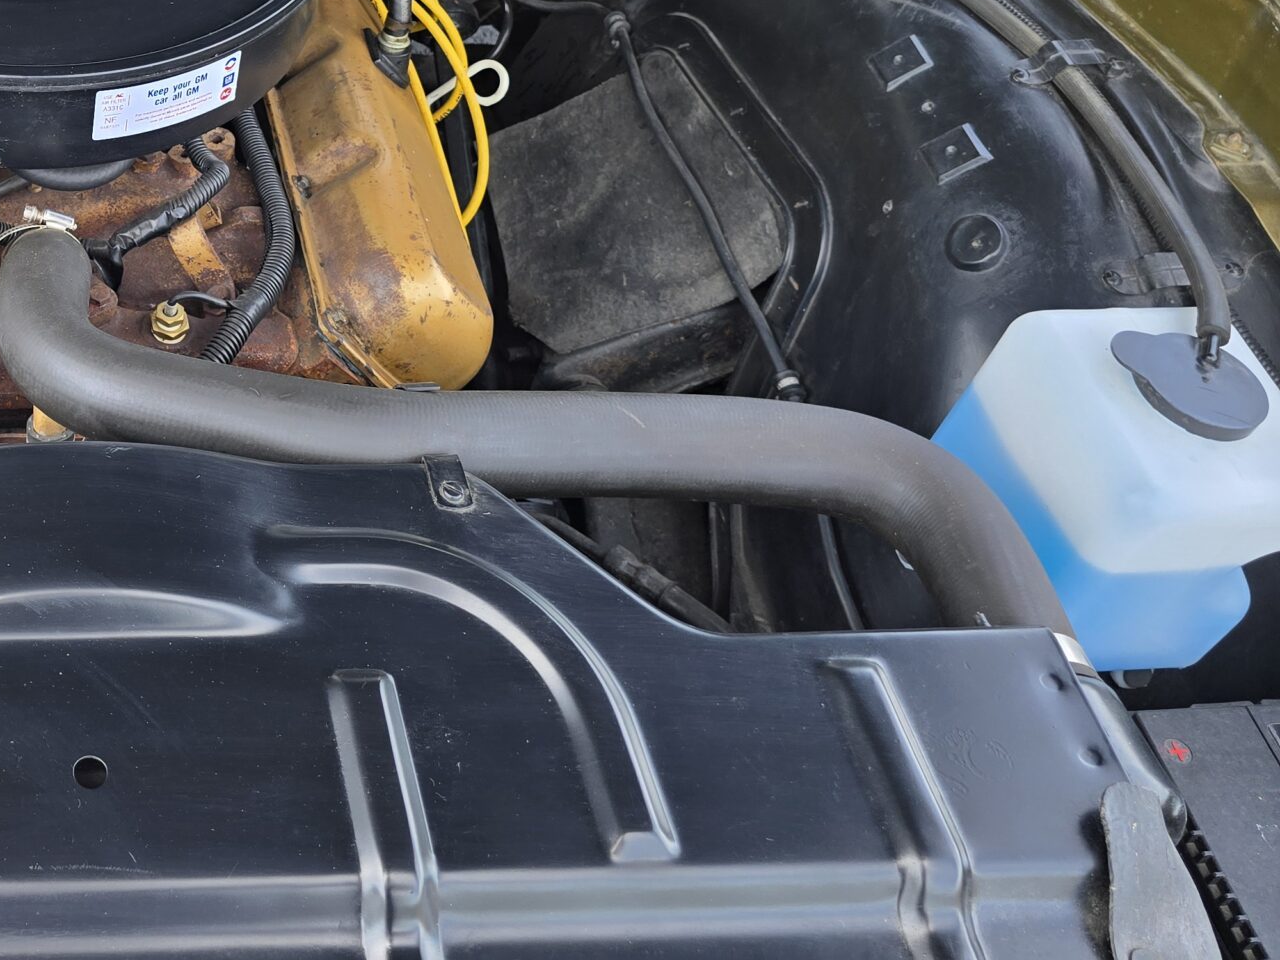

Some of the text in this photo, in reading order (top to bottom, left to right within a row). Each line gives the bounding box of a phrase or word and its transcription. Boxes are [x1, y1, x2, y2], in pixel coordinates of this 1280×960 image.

[147, 73, 208, 98] Keep your GM
[154, 85, 200, 105] car all GM
